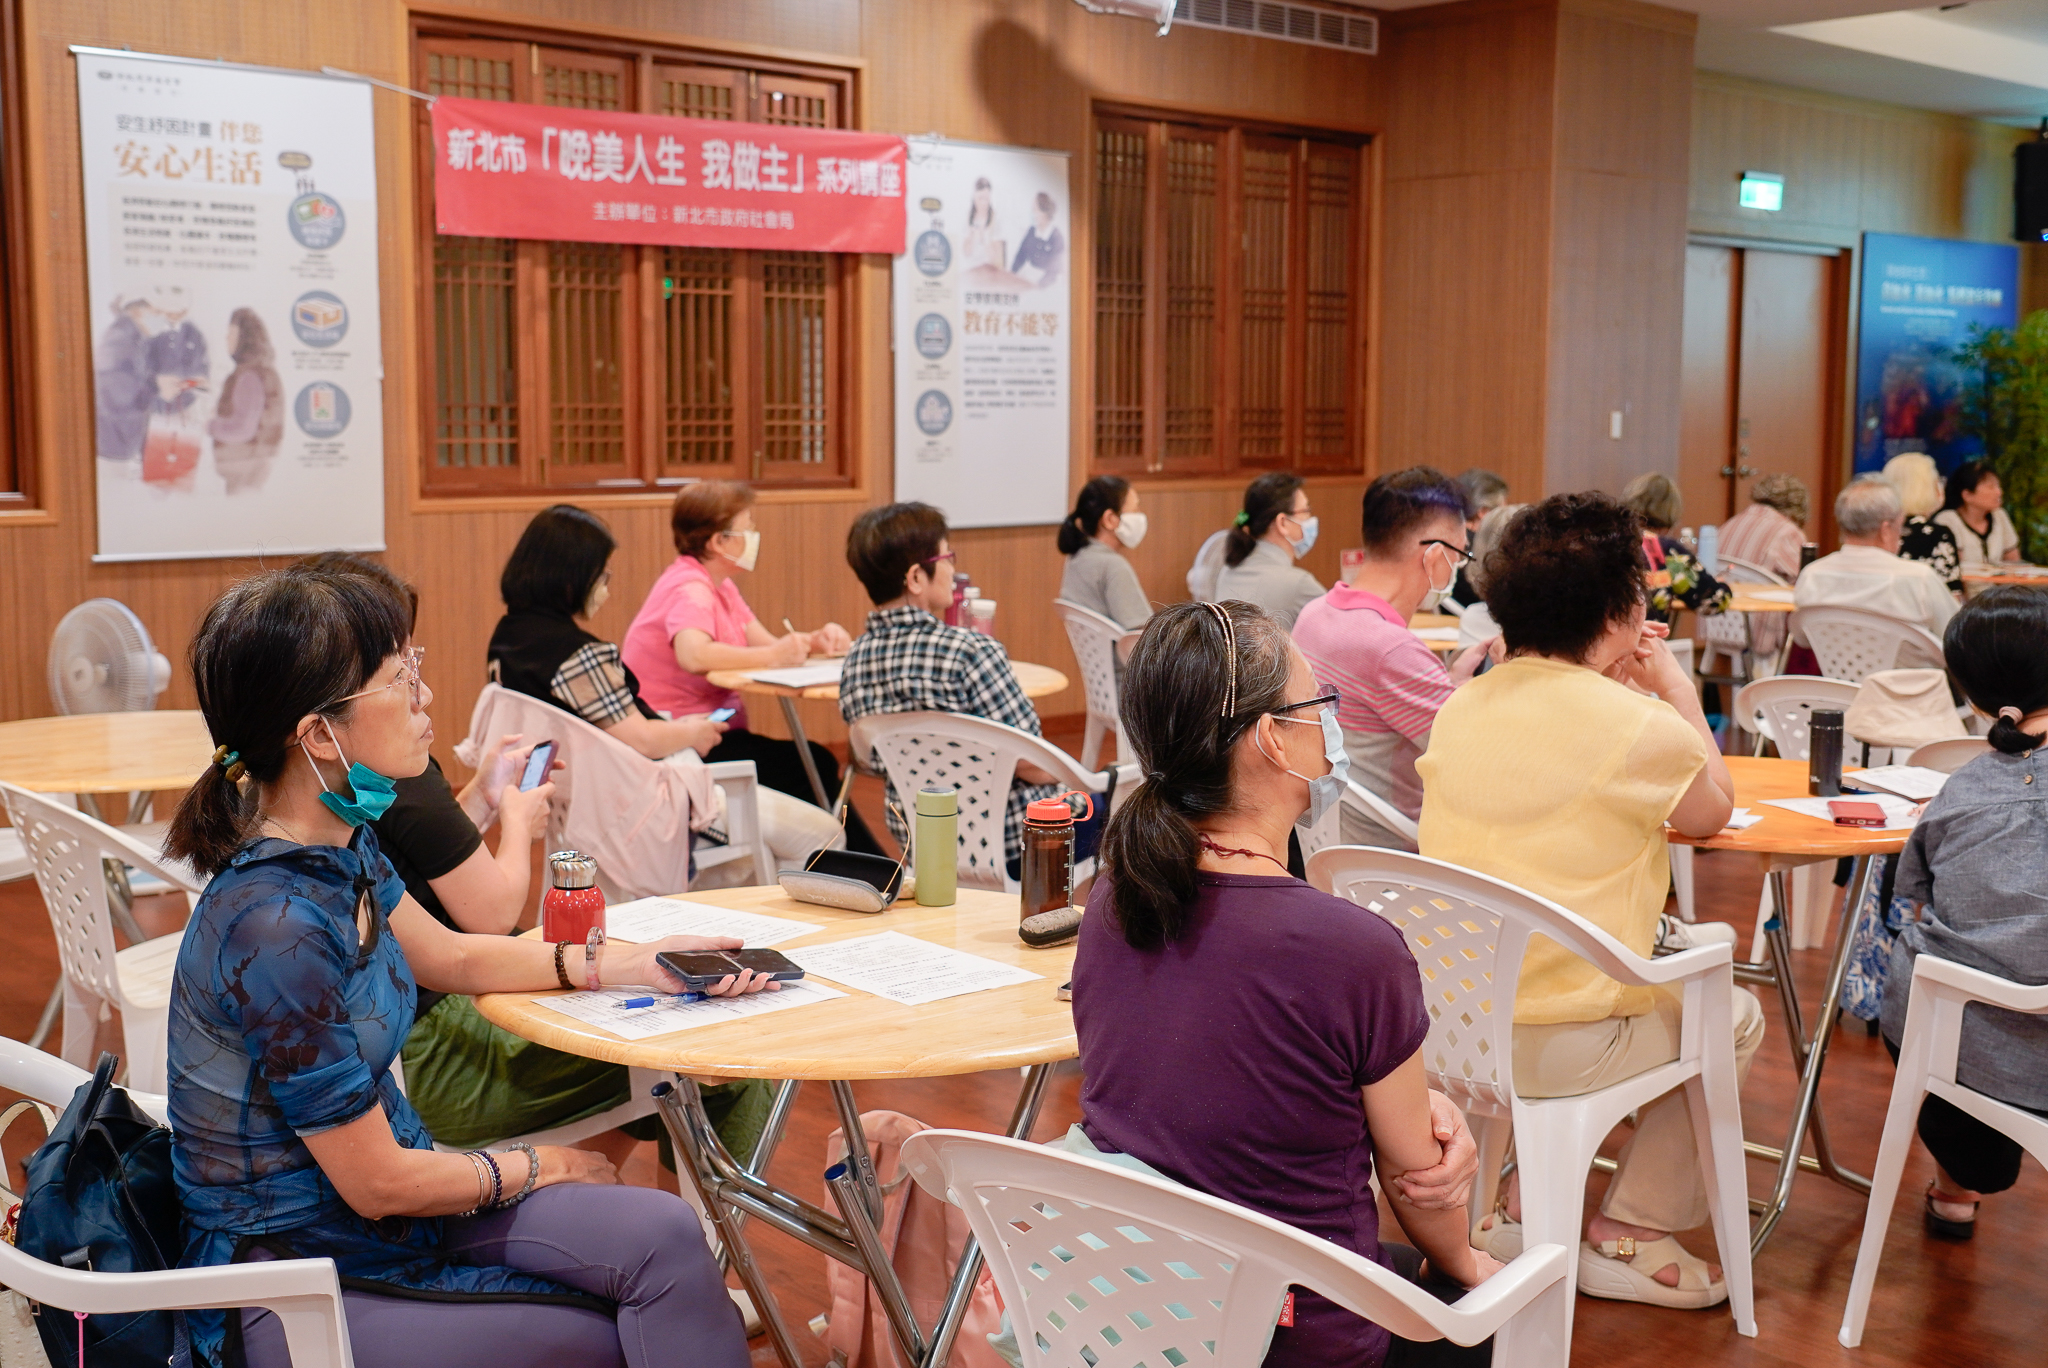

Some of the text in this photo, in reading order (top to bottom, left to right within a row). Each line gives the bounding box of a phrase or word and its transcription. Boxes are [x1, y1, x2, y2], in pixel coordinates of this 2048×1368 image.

[114, 139, 262, 186] 安心生活
[448, 128, 527, 175] 新北市
[702, 139, 805, 194] 我做主」
[816, 157, 901, 197] 系列講座
[964, 309, 1058, 337] 教育不能等
